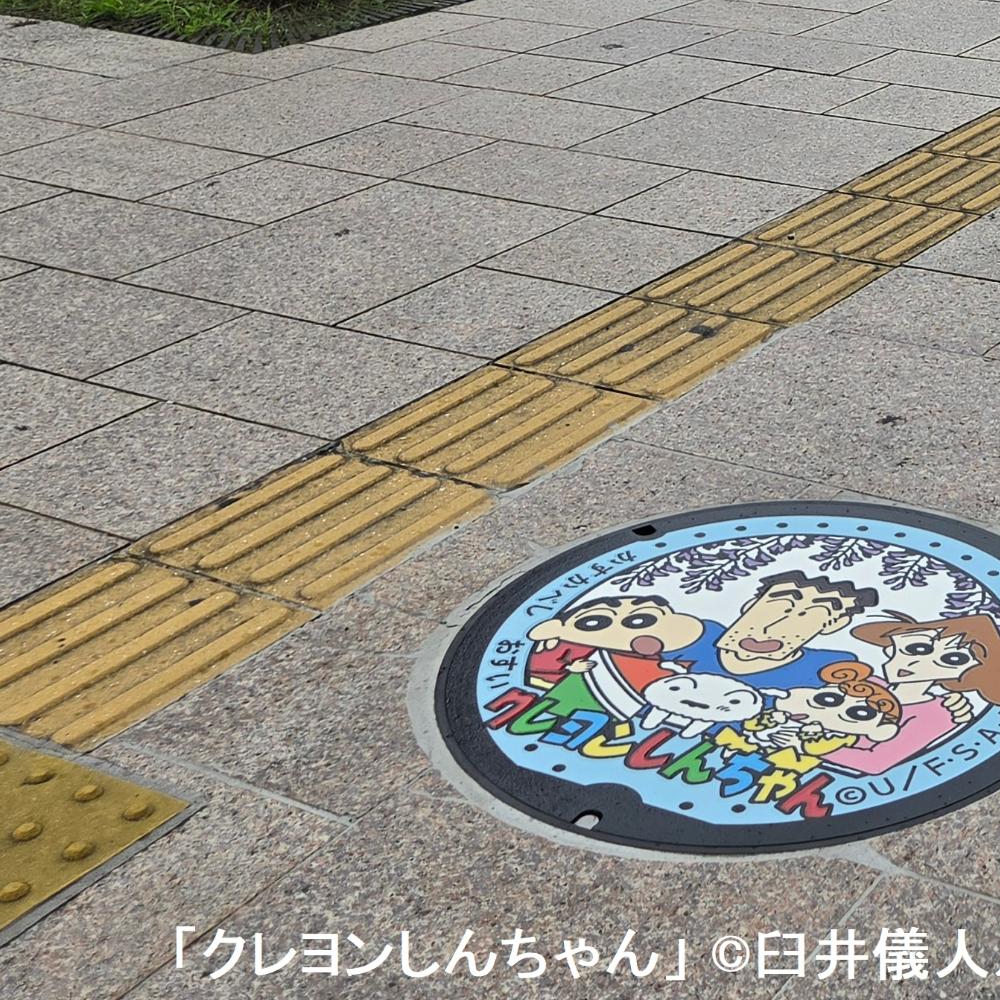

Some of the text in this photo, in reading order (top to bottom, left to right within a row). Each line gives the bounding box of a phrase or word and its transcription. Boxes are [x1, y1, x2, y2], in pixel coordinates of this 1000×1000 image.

[526, 550, 637, 617] かすかべし
[485, 639, 526, 689] おすい
[484, 687, 834, 819] クレヨンしんちゃん
